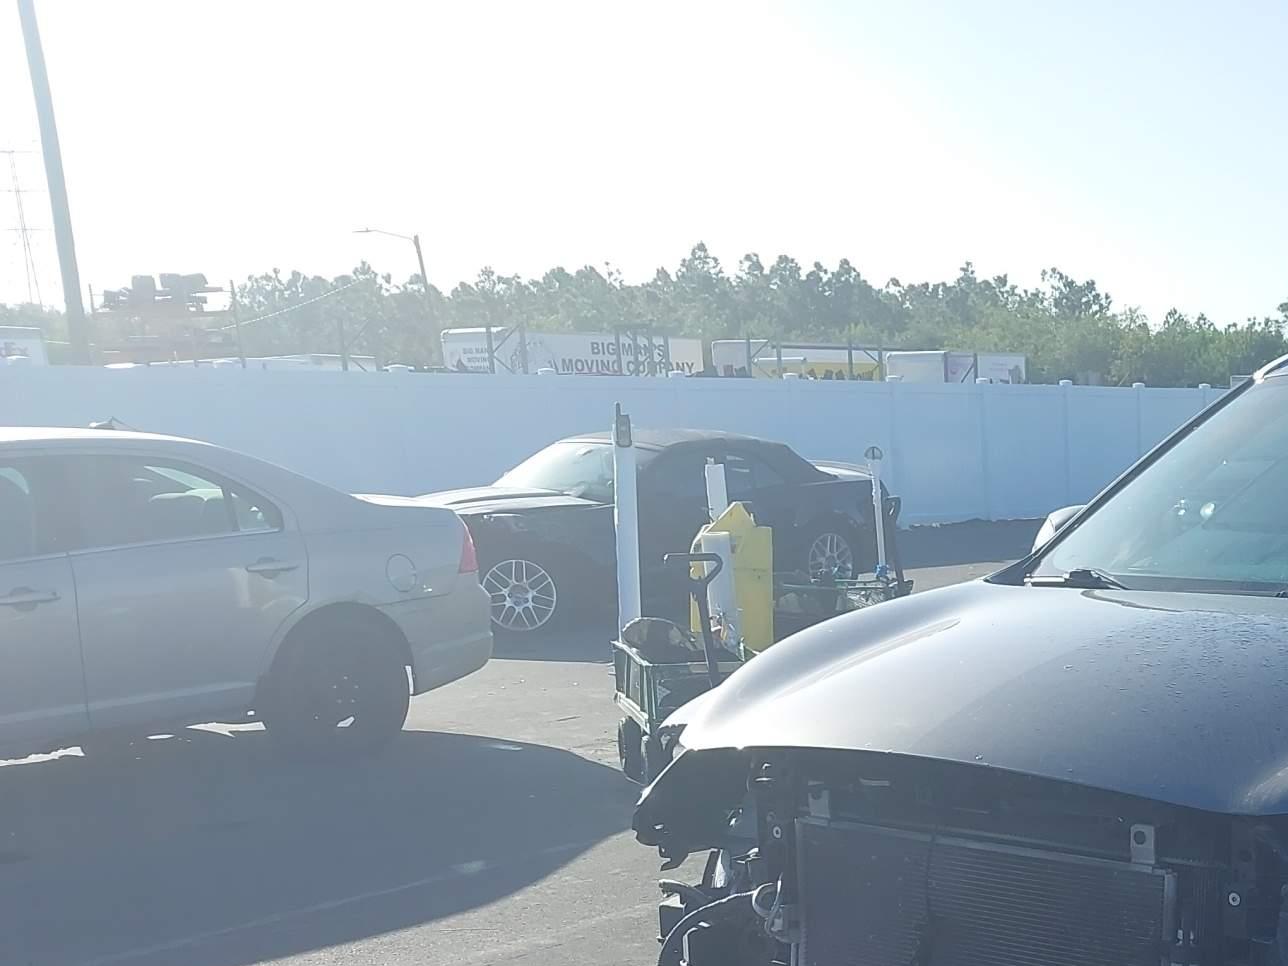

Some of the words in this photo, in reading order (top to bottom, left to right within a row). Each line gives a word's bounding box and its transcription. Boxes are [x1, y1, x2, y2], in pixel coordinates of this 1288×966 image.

[591, 342, 616, 356] BIG
[622, 343, 664, 357] MN'S
[561, 358, 620, 373] MOVING
[627, 360, 694, 374] COPNY
